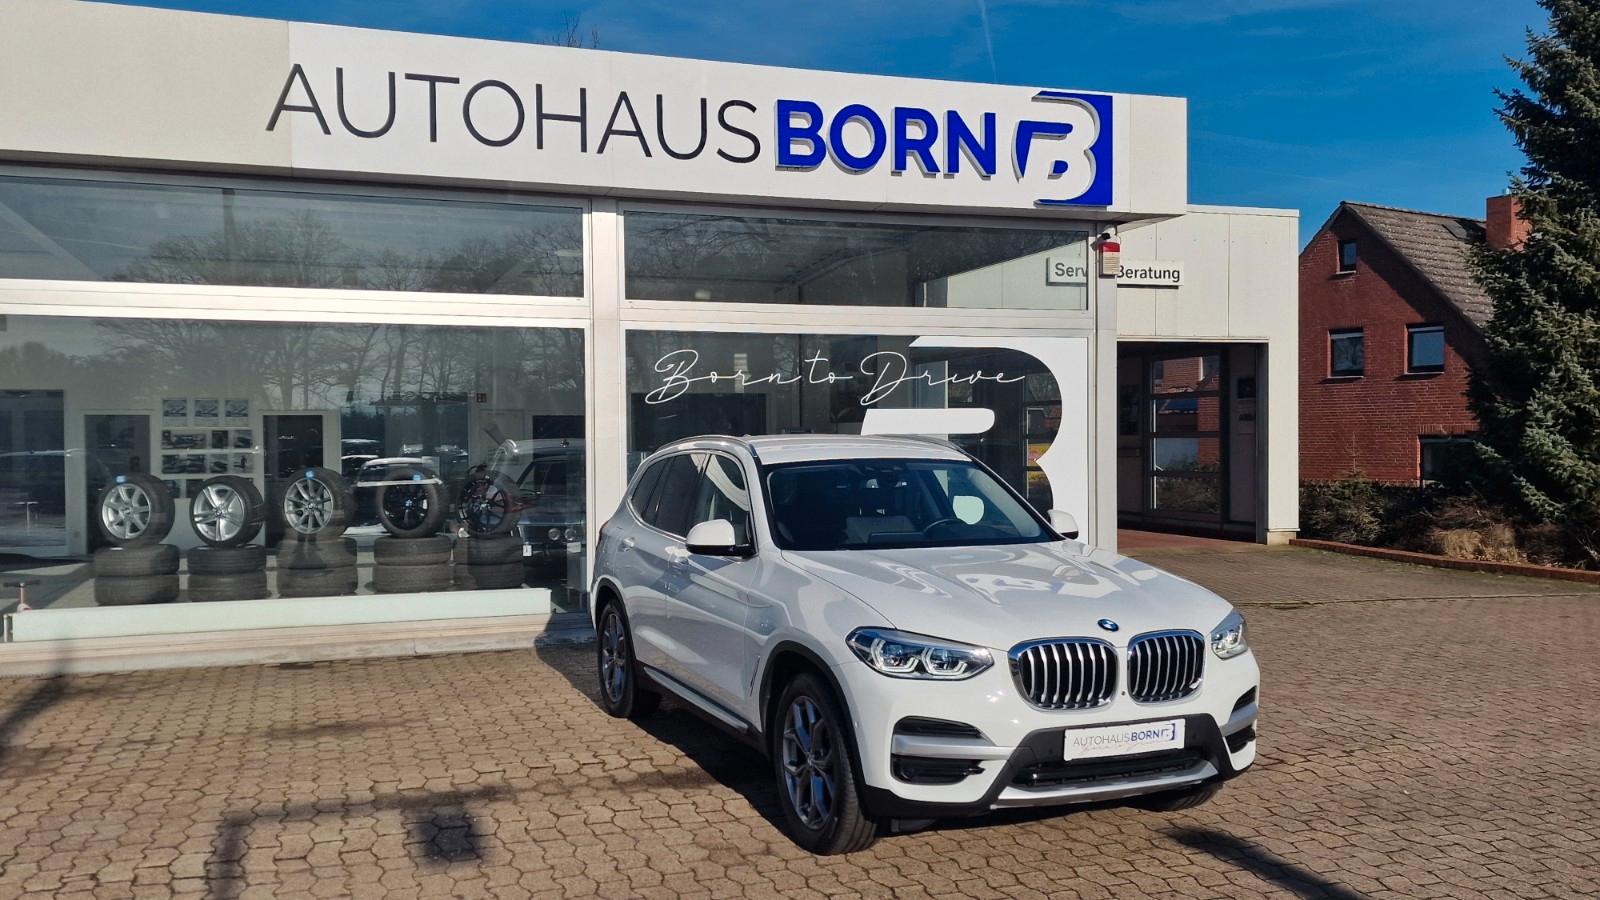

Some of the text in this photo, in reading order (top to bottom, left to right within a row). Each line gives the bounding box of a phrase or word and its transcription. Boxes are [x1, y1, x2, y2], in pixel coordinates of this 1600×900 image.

[1117, 265, 1180, 282] Beratung
[645, 349, 1026, 406] Born to Drive
